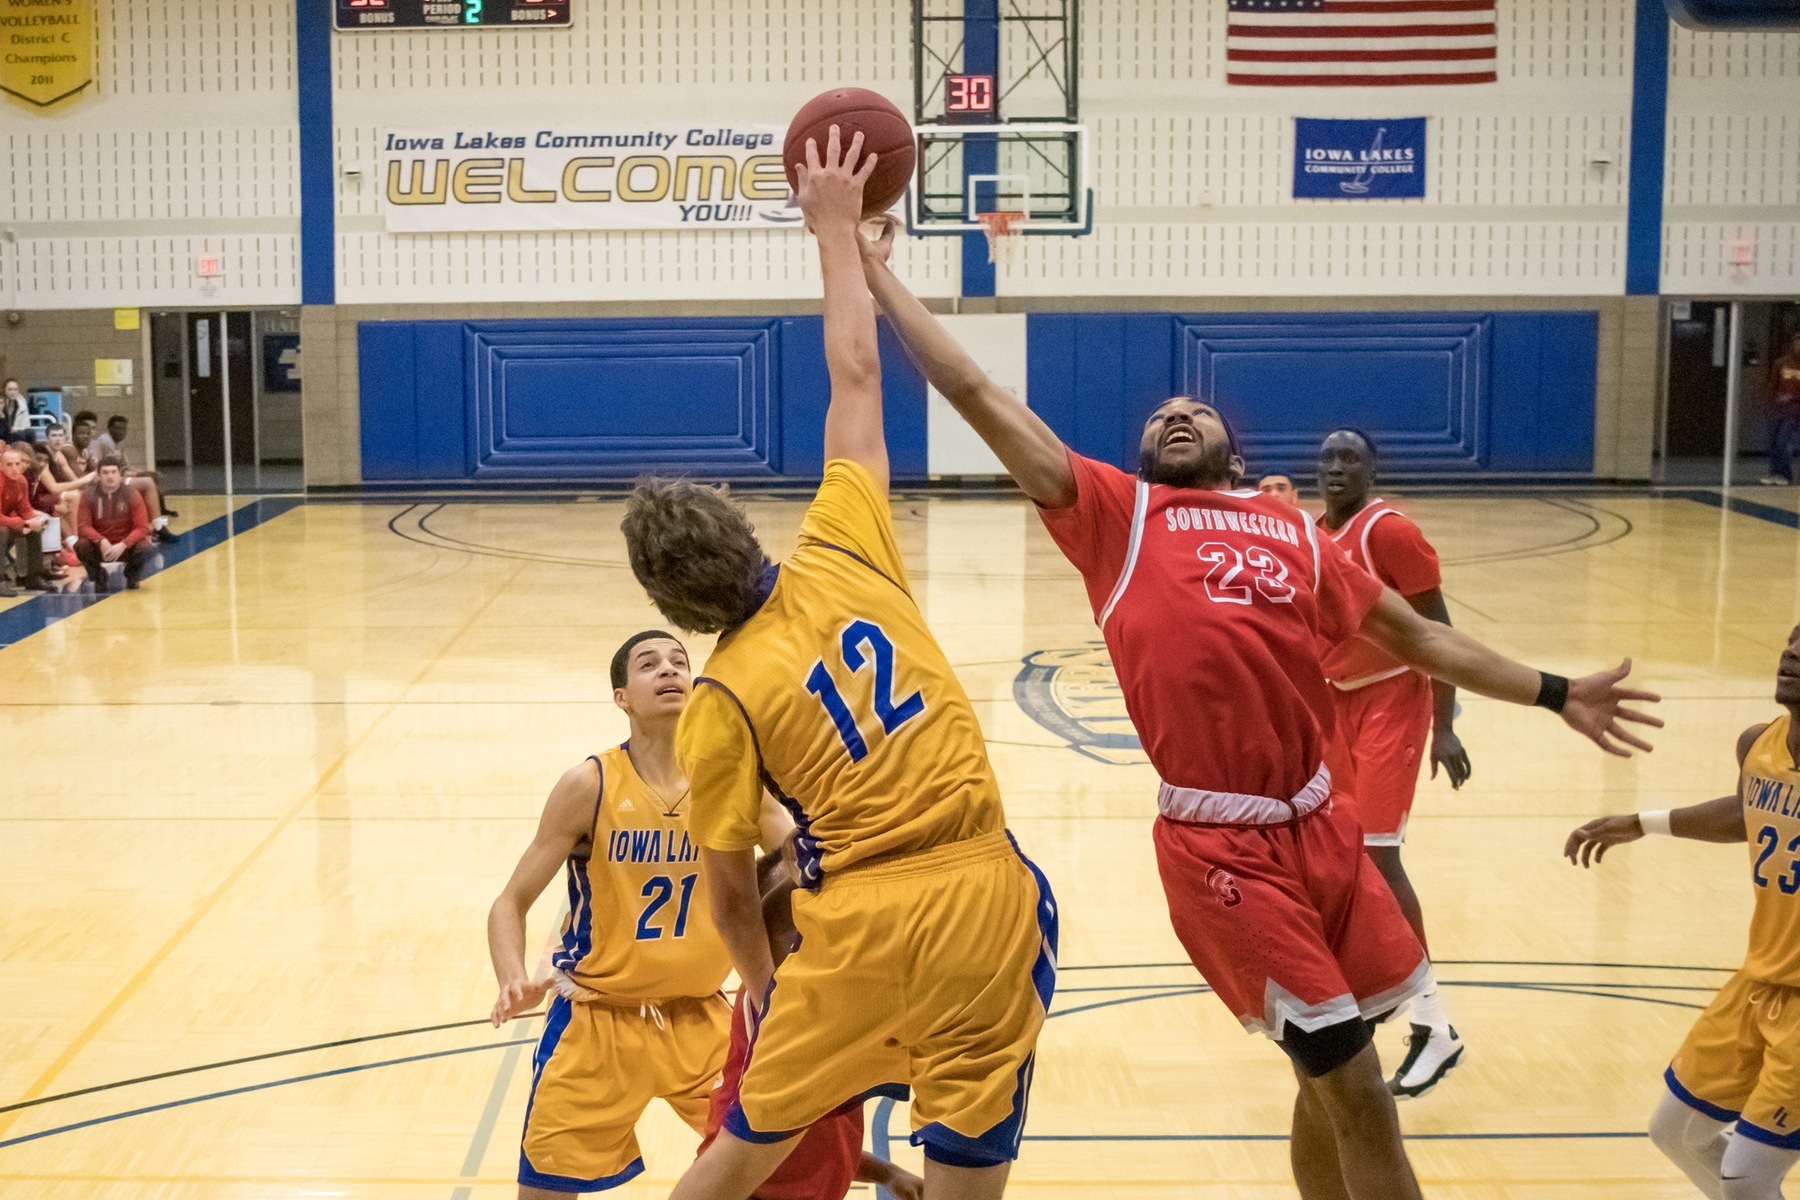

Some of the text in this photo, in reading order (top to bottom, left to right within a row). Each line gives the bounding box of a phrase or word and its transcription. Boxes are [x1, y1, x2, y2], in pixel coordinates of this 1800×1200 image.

[359, 12, 395, 23] BONUS
[423, 4, 461, 15] PERIOD
[466, 0, 481, 23] 2
[511, 9, 546, 20] BONUS
[0, 14, 80, 27] VOLLEYBALL
[11, 32, 70, 44] District C
[5, 53, 77, 66] Champions
[31, 75, 54, 85] 2011
[949, 77, 990, 110] 30
[386, 129, 774, 150] Iowa Lakes Community College
[1305, 147, 1415, 161] IOWA LAKES
[1304, 164, 1413, 174] COMMUNITY COLLEGE
[386, 155, 790, 205] WELCOME
[679, 204, 753, 222] YOU!!!
[1165, 507, 1299, 548] SOUTHWESTERN
[1197, 542, 1295, 605] 23
[802, 617, 929, 765] 12
[1746, 775, 1784, 813] IOWA
[607, 829, 661, 863] IOWA
[1753, 824, 1800, 896] 23
[635, 872, 700, 942] 21
